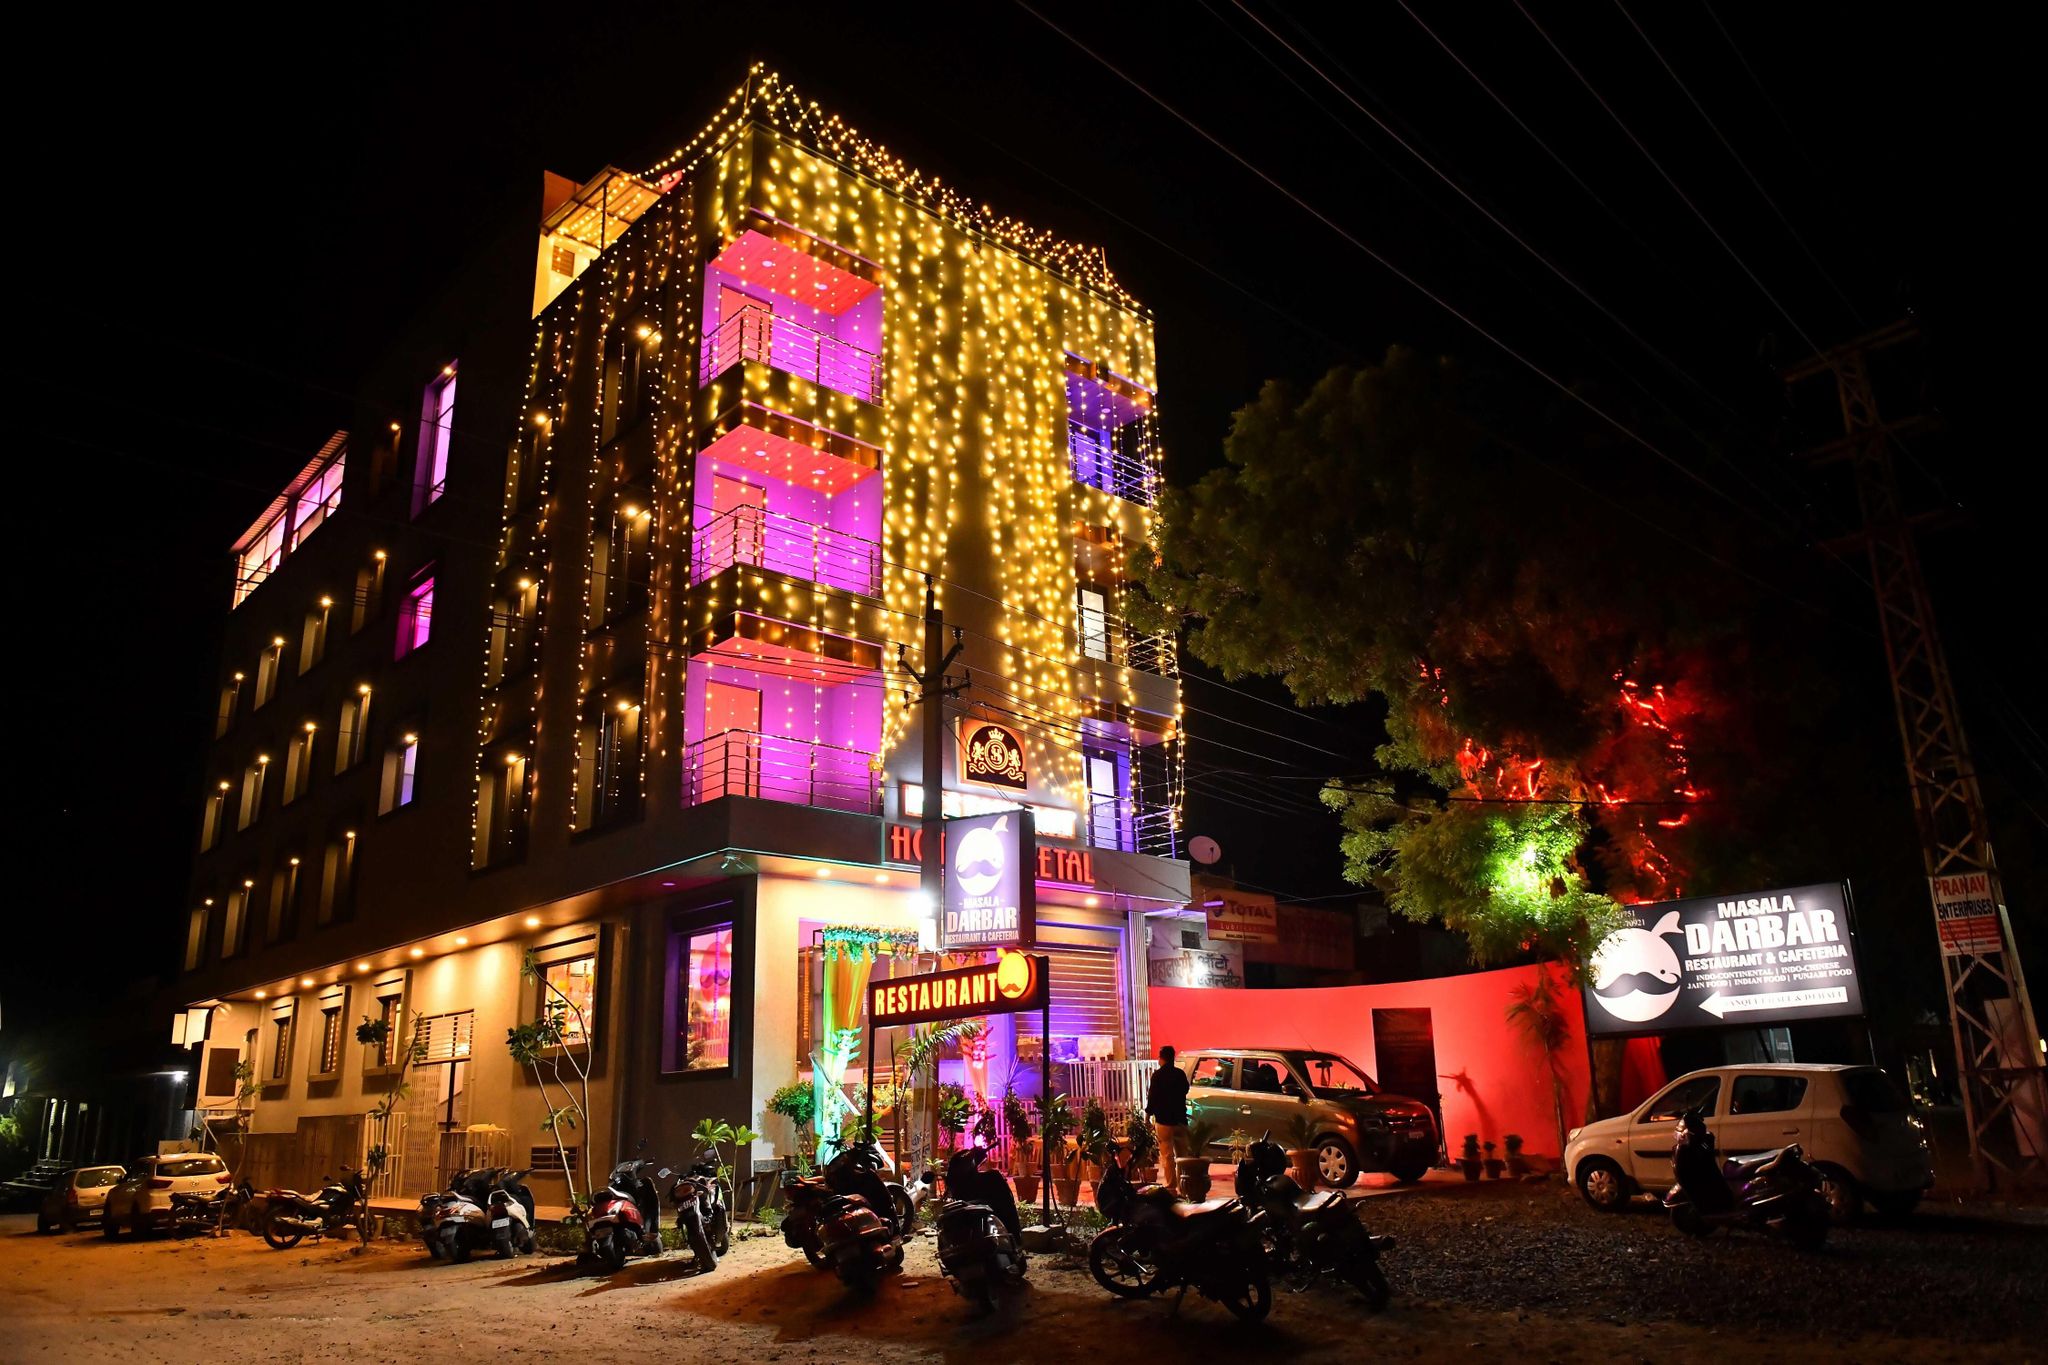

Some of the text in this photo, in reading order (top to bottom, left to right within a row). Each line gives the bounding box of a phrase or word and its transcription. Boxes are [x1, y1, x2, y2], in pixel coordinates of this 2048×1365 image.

[1037, 846, 1096, 884] ETAL
[1934, 875, 1986, 896] PRANAV
[964, 896, 1000, 909] MASALA
[1227, 900, 1273, 920] TOTAL
[1718, 895, 1796, 919] MASALA
[1935, 898, 1993, 919] ENTERPRISES
[946, 906, 1018, 933] DARBAR
[945, 930, 1020, 945] RESTAURANT & CAFETERIA
[1684, 909, 1840, 956] DARBAR
[1685, 945, 1848, 972] RESTAURANT & CAFETERIA
[1687, 980, 1706, 990] JAIN
[1734, 976, 1763, 986] INDIAN
[1764, 973, 1786, 984] FOOD
[1793, 971, 1828, 981] PUNJABI
[1829, 967, 1853, 978] FOOD
[1696, 961, 1841, 981] INDO-CONTINENTAL INDO-CHINESE
[874, 973, 998, 1017] RESTAURANT
